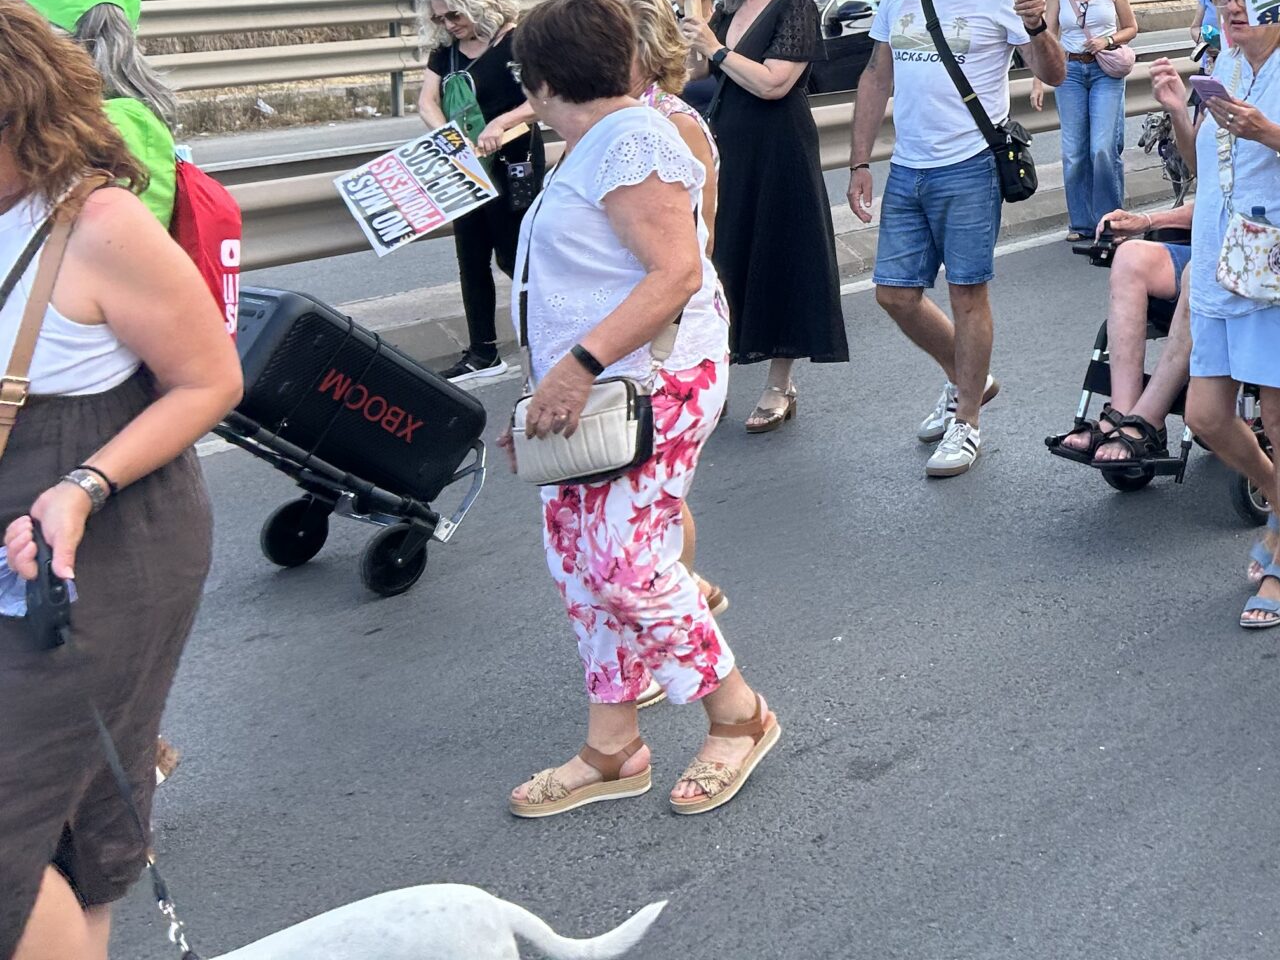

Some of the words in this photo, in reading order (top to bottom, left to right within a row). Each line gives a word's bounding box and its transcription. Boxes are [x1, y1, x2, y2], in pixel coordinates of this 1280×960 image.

[346, 173, 394, 216] MÁS
[371, 156, 442, 231] PROMESAS
[399, 139, 491, 214] ACCESOS
[371, 208, 414, 243] NO
[318, 367, 424, 444] XBOOM
